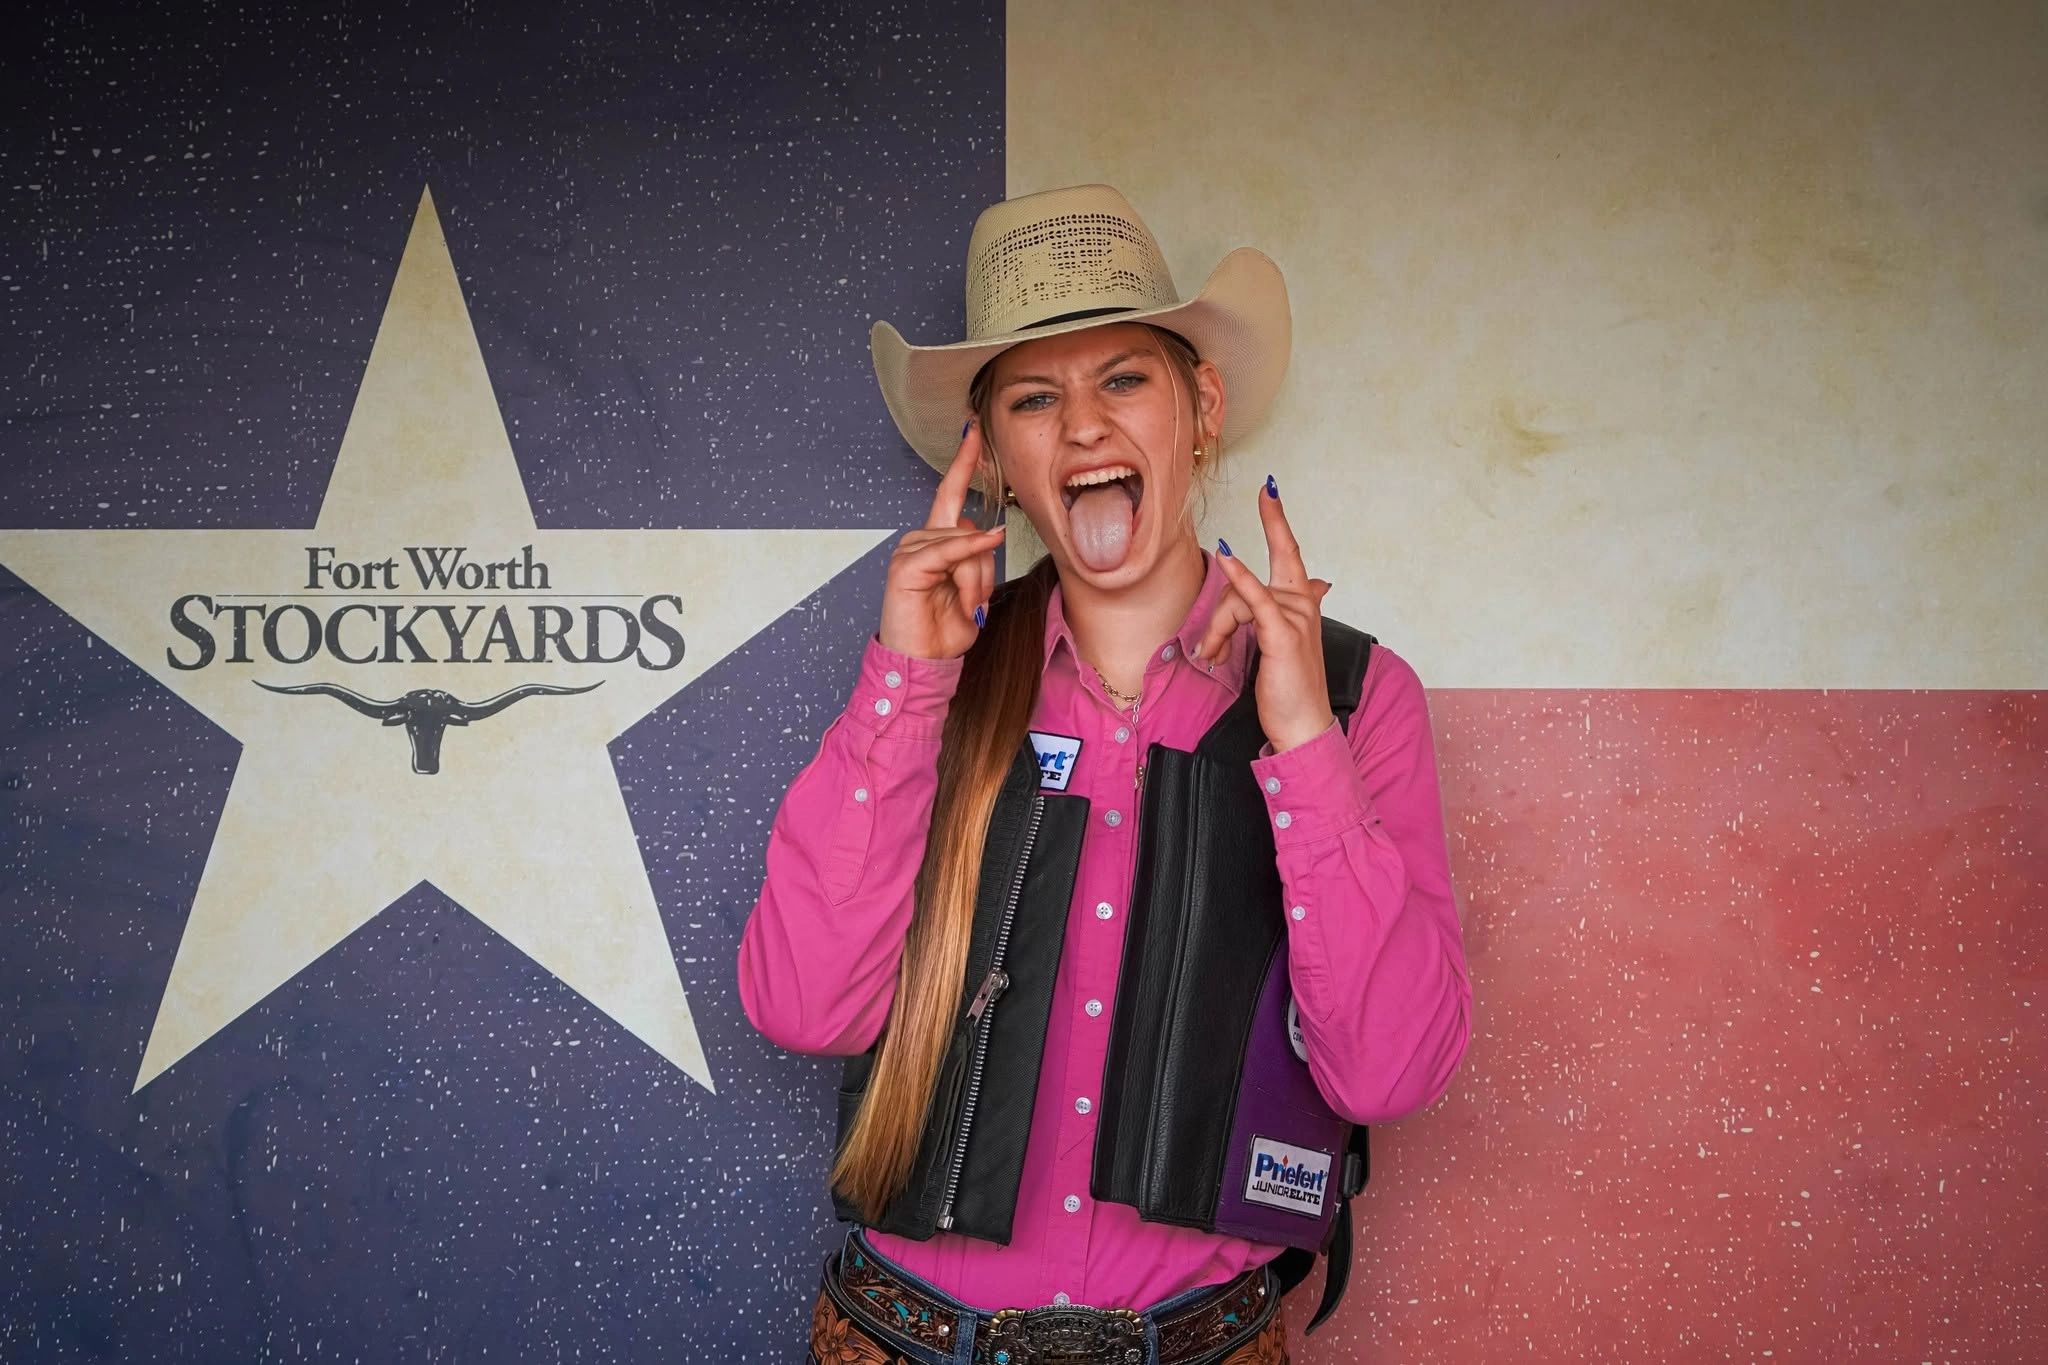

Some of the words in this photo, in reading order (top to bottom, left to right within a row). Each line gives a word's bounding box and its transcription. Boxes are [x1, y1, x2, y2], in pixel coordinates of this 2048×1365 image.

[304, 547, 399, 590] Fort
[403, 545, 552, 591] Worth
[166, 594, 686, 671] STOCKYARDS
[1254, 1152, 1324, 1192] Priefert
